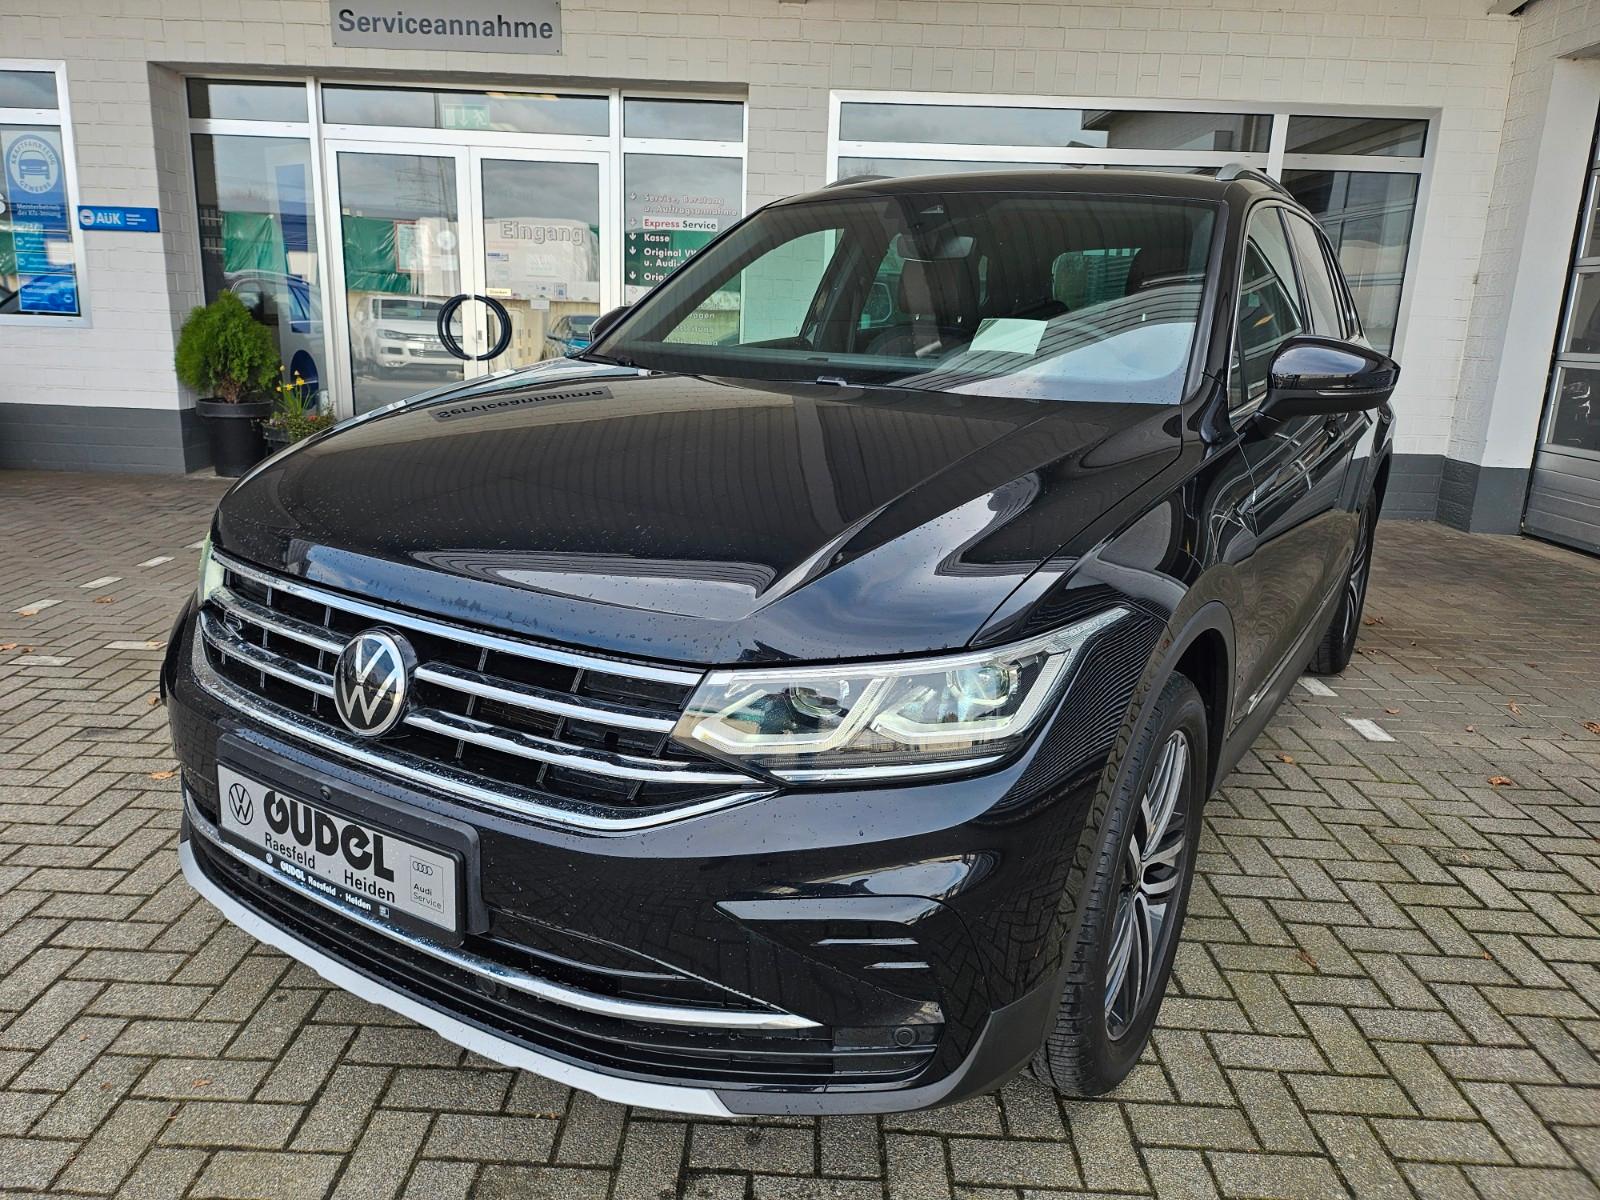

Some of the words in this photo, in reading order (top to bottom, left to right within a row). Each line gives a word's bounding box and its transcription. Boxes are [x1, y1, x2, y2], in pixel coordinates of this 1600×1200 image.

[338, 8, 553, 39] Serviceannahme
[643, 218, 680, 229] Express
[682, 220, 717, 230] Service
[500, 219, 585, 247] Eingang
[643, 233, 670, 242] Kasse
[643, 247, 682, 258] Original
[643, 260, 653, 268] u.
[264, 831, 316, 870] Raesfeld
[344, 868, 396, 903] Heiden
[308, 875, 337, 896] Raesfeld
[345, 892, 372, 911] Heiden
[413, 882, 432, 896] Audi
[413, 891, 443, 909] Service
